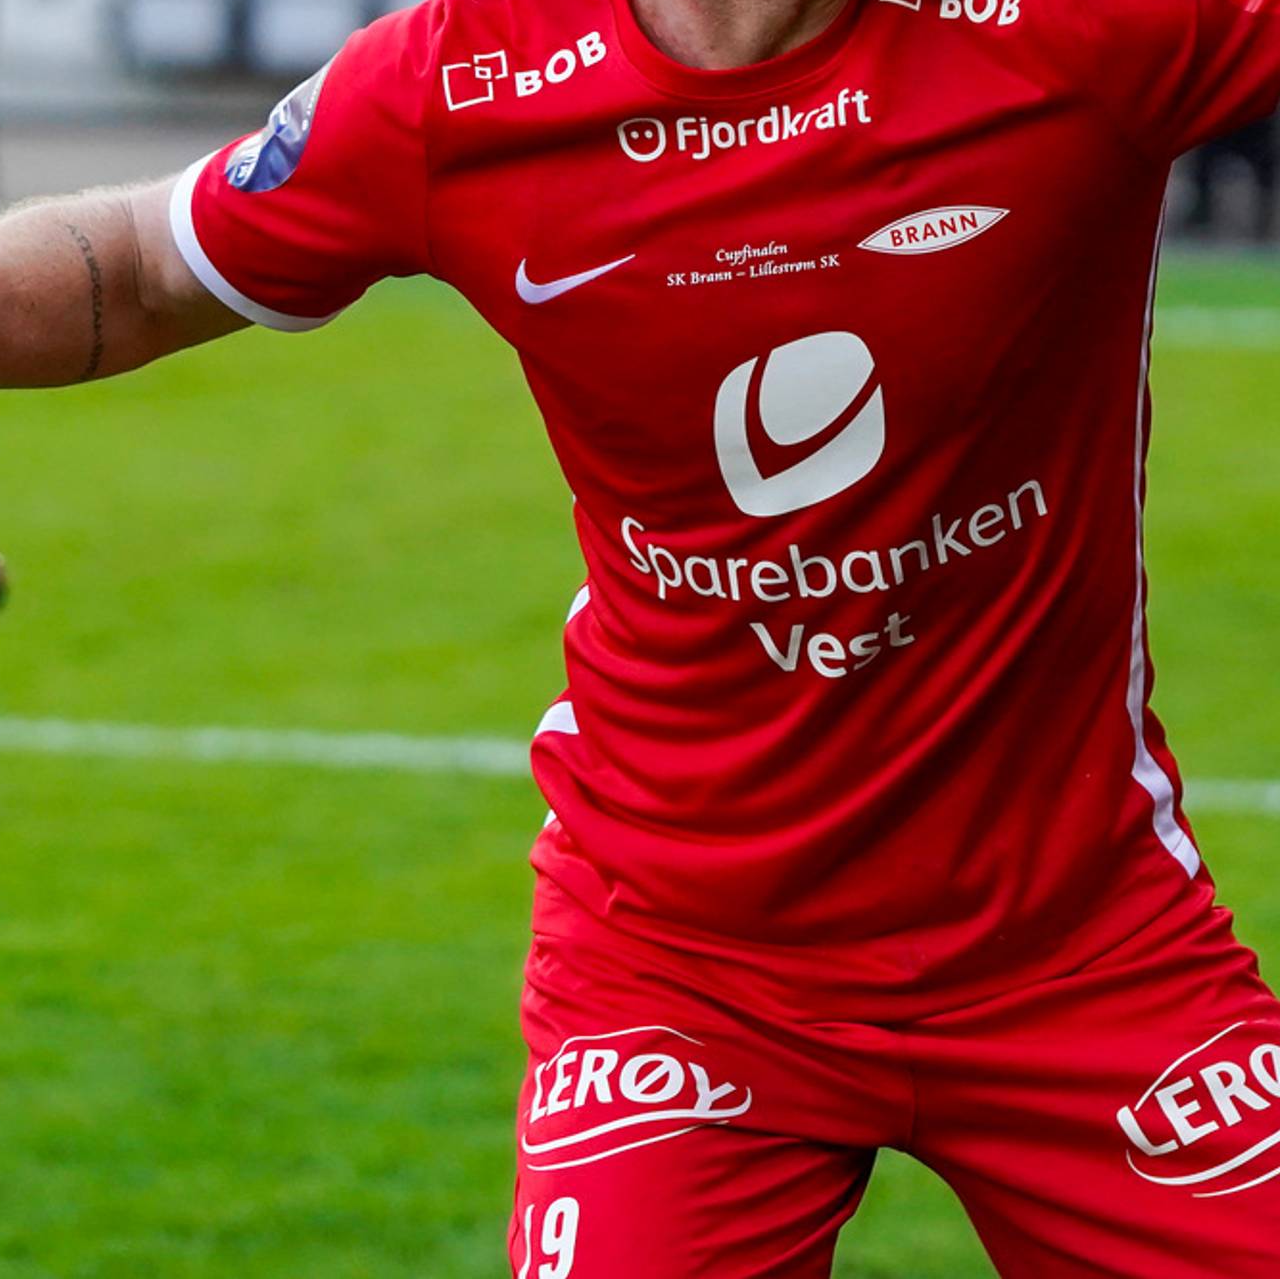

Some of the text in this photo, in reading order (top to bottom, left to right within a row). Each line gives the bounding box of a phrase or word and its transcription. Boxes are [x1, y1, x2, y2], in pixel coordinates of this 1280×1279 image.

[515, 31, 608, 97] BOB
[676, 87, 872, 160] Fjordkraft
[715, 241, 788, 266] Cupfinalen
[889, 211, 980, 247] BRANN
[667, 272, 687, 287] SK
[690, 270, 733, 285] Brann
[749, 259, 817, 279] Lillestrøm
[820, 254, 841, 269] SK
[621, 479, 1048, 602] Sparebanken
[750, 612, 916, 678] Vest
[530, 1048, 738, 1123] LERØY
